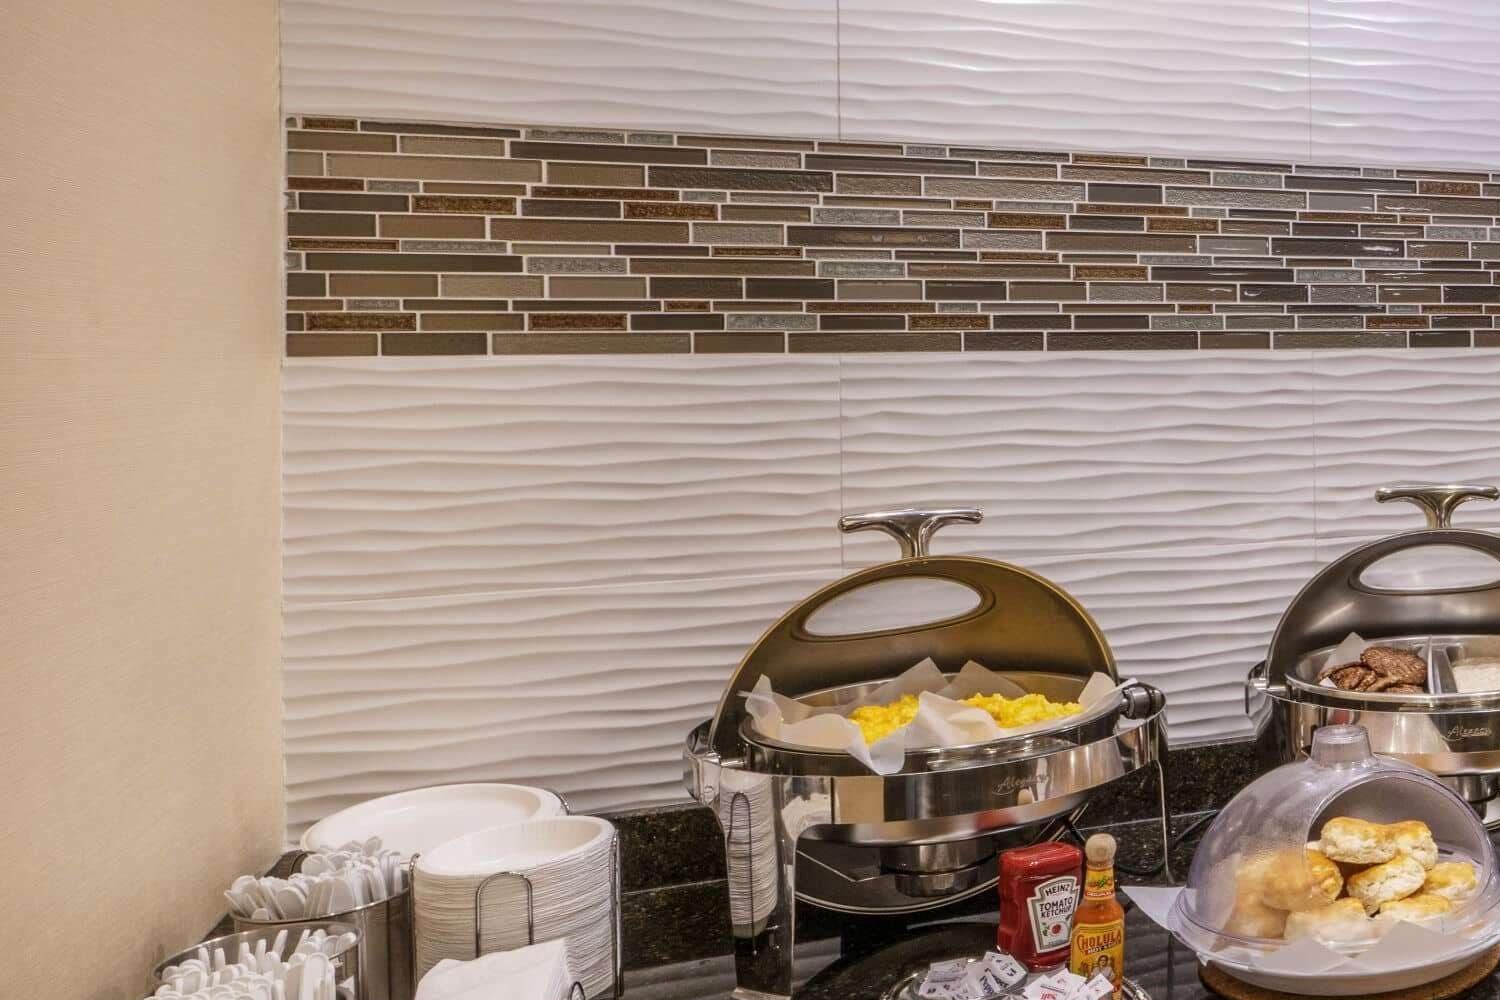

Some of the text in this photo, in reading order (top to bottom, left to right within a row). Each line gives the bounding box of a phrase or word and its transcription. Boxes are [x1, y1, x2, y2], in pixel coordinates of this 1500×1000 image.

[1044, 882, 1071, 897] HEINZ
[1039, 896, 1074, 912] TOMATO
[1040, 905, 1073, 918] KETCHUP
[1076, 929, 1122, 953] CHOLULA
